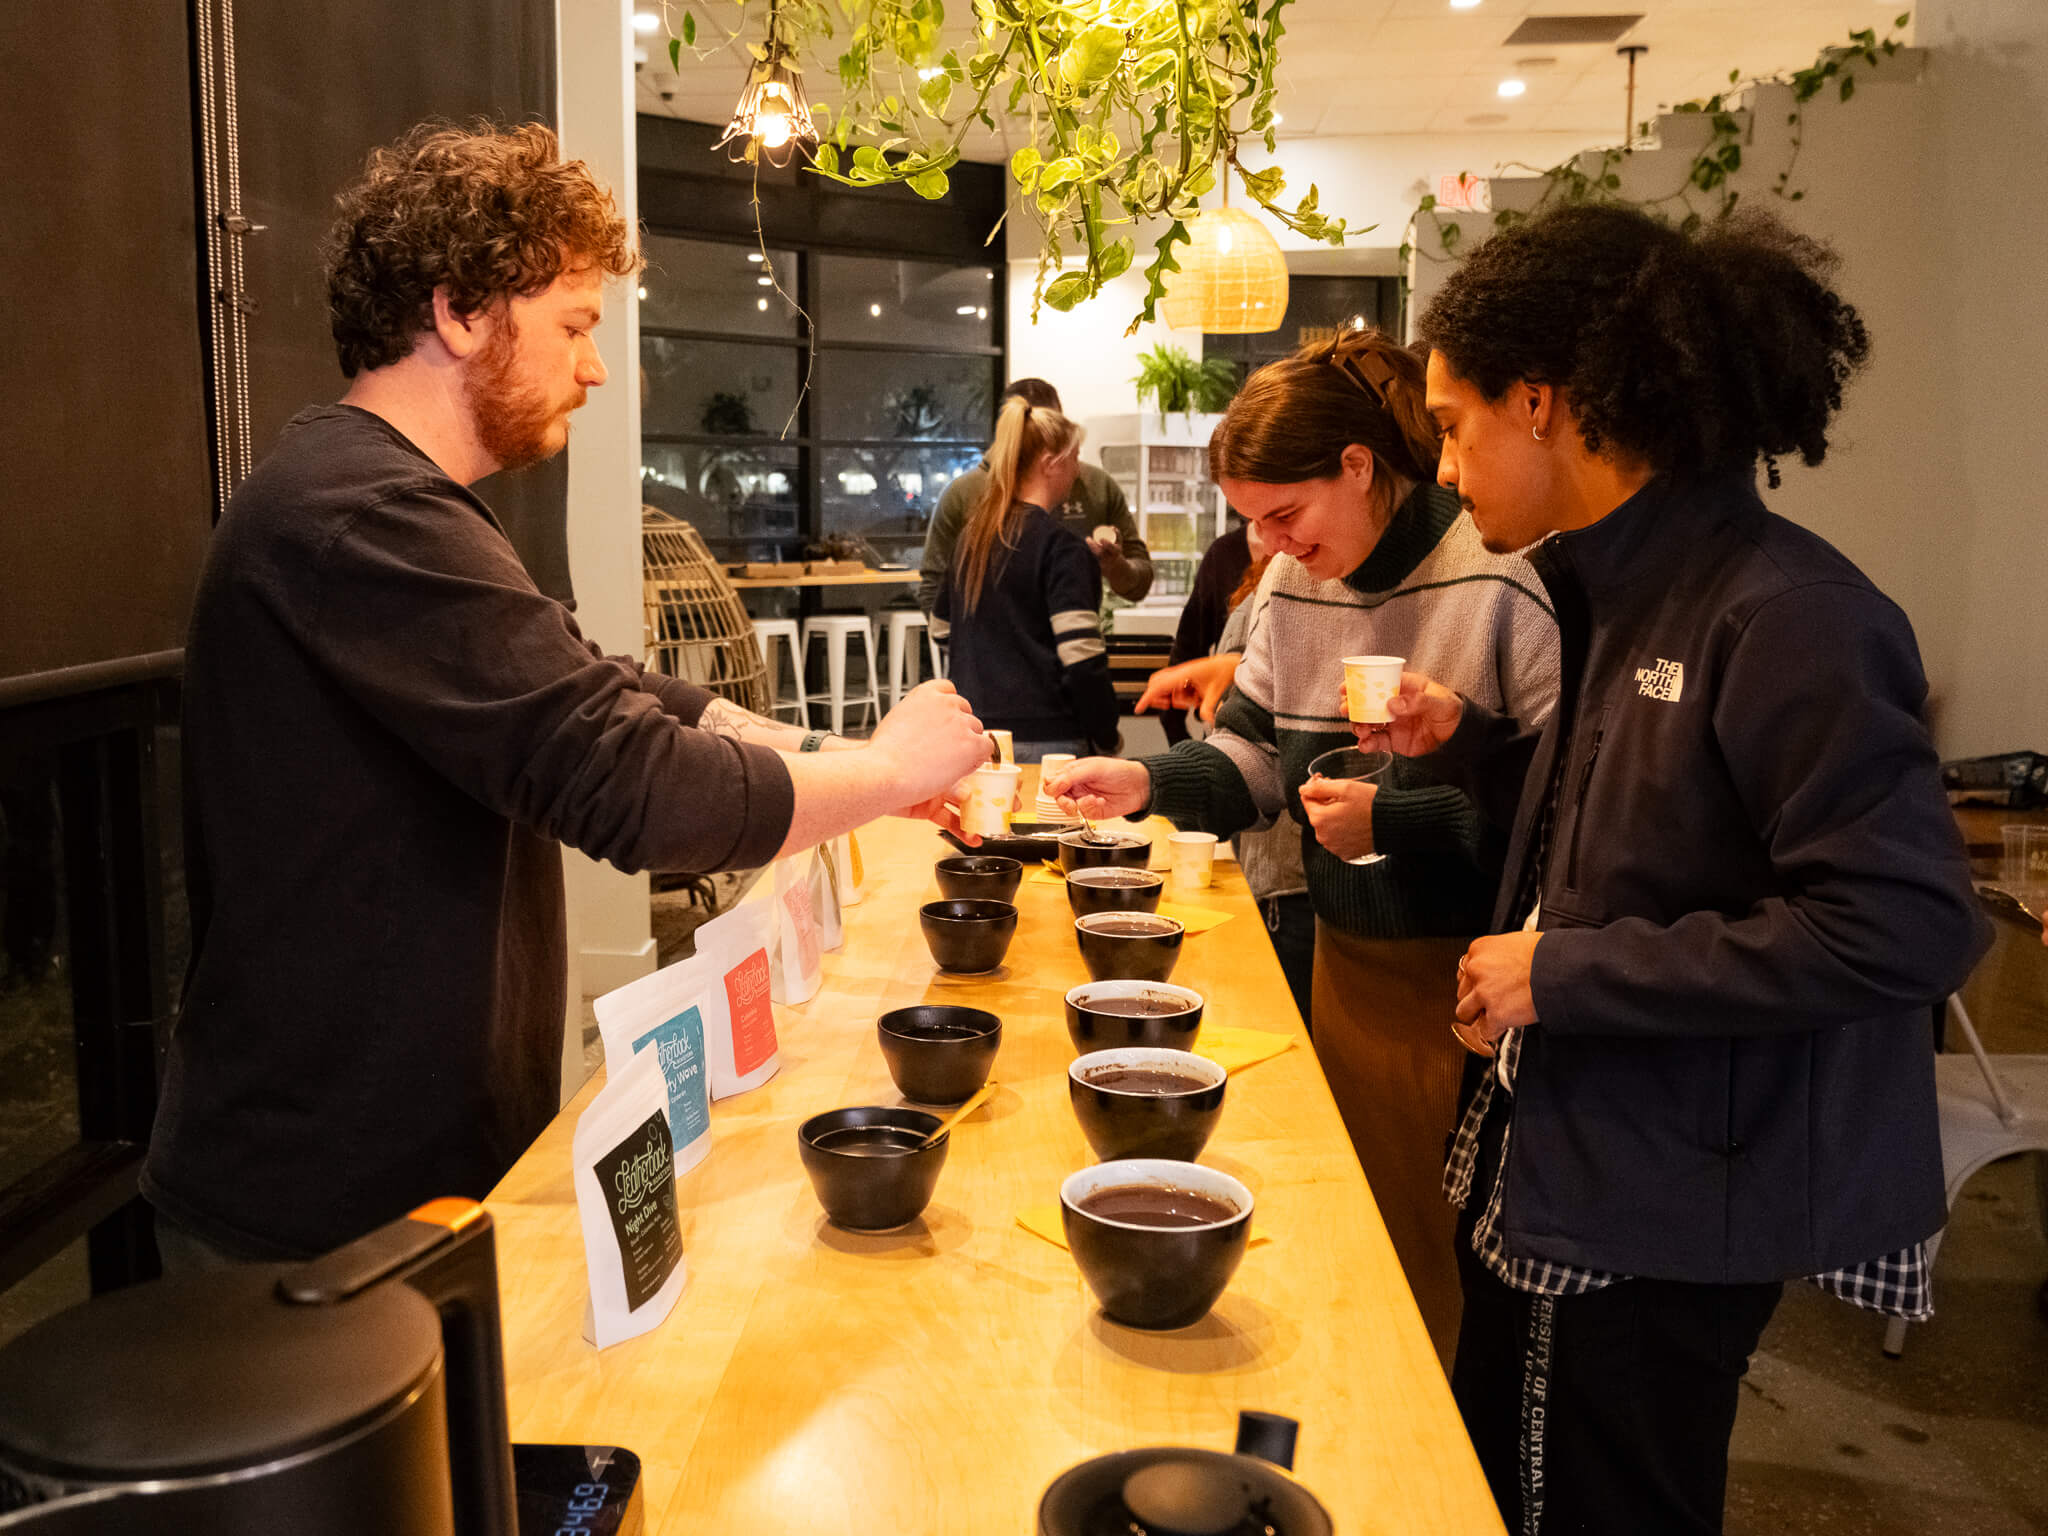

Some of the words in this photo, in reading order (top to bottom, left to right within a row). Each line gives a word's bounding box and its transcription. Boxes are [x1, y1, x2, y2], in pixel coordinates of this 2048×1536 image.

[1634, 667, 1676, 688] NORTH
[1656, 658, 1680, 676] THE
[1638, 682, 1673, 701] FACE
[676, 1064, 699, 1084] Wave
[625, 1211, 645, 1237] Night
[642, 1200, 658, 1219] Dive
[1533, 1376, 1547, 1401] OF
[1530, 1407, 1546, 1494] CENTRAL
